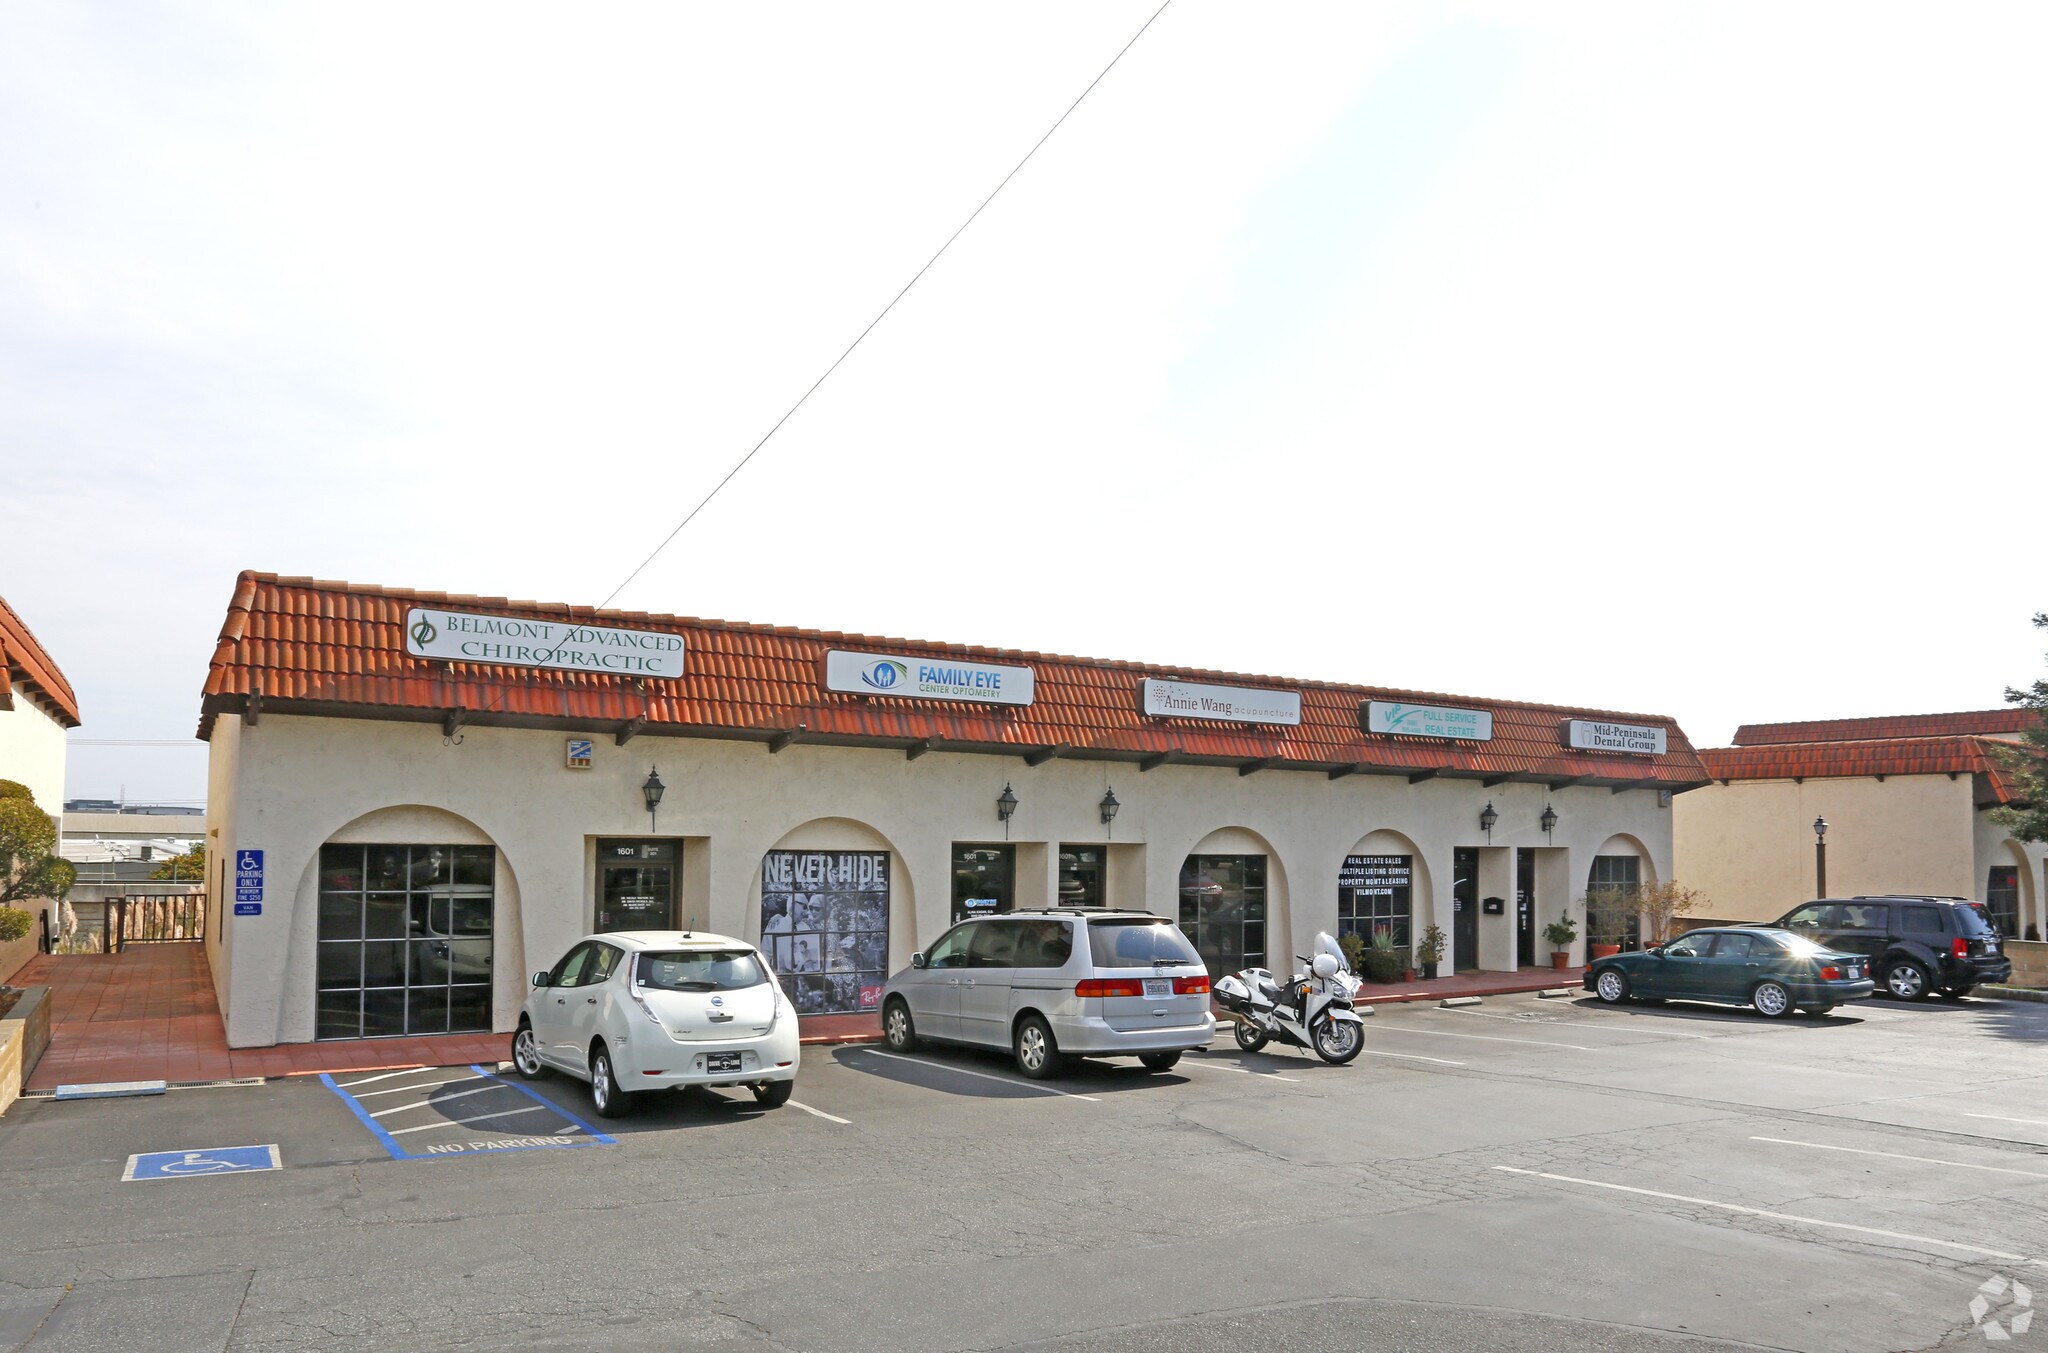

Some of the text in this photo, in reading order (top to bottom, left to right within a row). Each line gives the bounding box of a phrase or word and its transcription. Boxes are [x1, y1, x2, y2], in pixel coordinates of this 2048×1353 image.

[447, 616, 682, 652] BELMONT ADVANCED
[461, 641, 662, 671] CHIROPRACTIC
[919, 666, 1001, 689] FAMILY EYE
[919, 684, 1001, 697] CENTER OPTOMETRY
[1164, 695, 1232, 716] Annie Wang
[1234, 706, 1294, 718] acupuncture
[1385, 704, 1401, 722] VIP
[1423, 710, 1477, 724] FULL SERVICE
[1425, 724, 1446, 735] REAL
[1448, 727, 1475, 737] ESTATE
[1594, 724, 1656, 740] Mid-Peninsula
[1594, 735, 1656, 752] Dental Group
[617, 847, 634, 855] 1601
[764, 855, 885, 883] NEVER HIDE
[426, 1135, 573, 1155] NO PARKING
